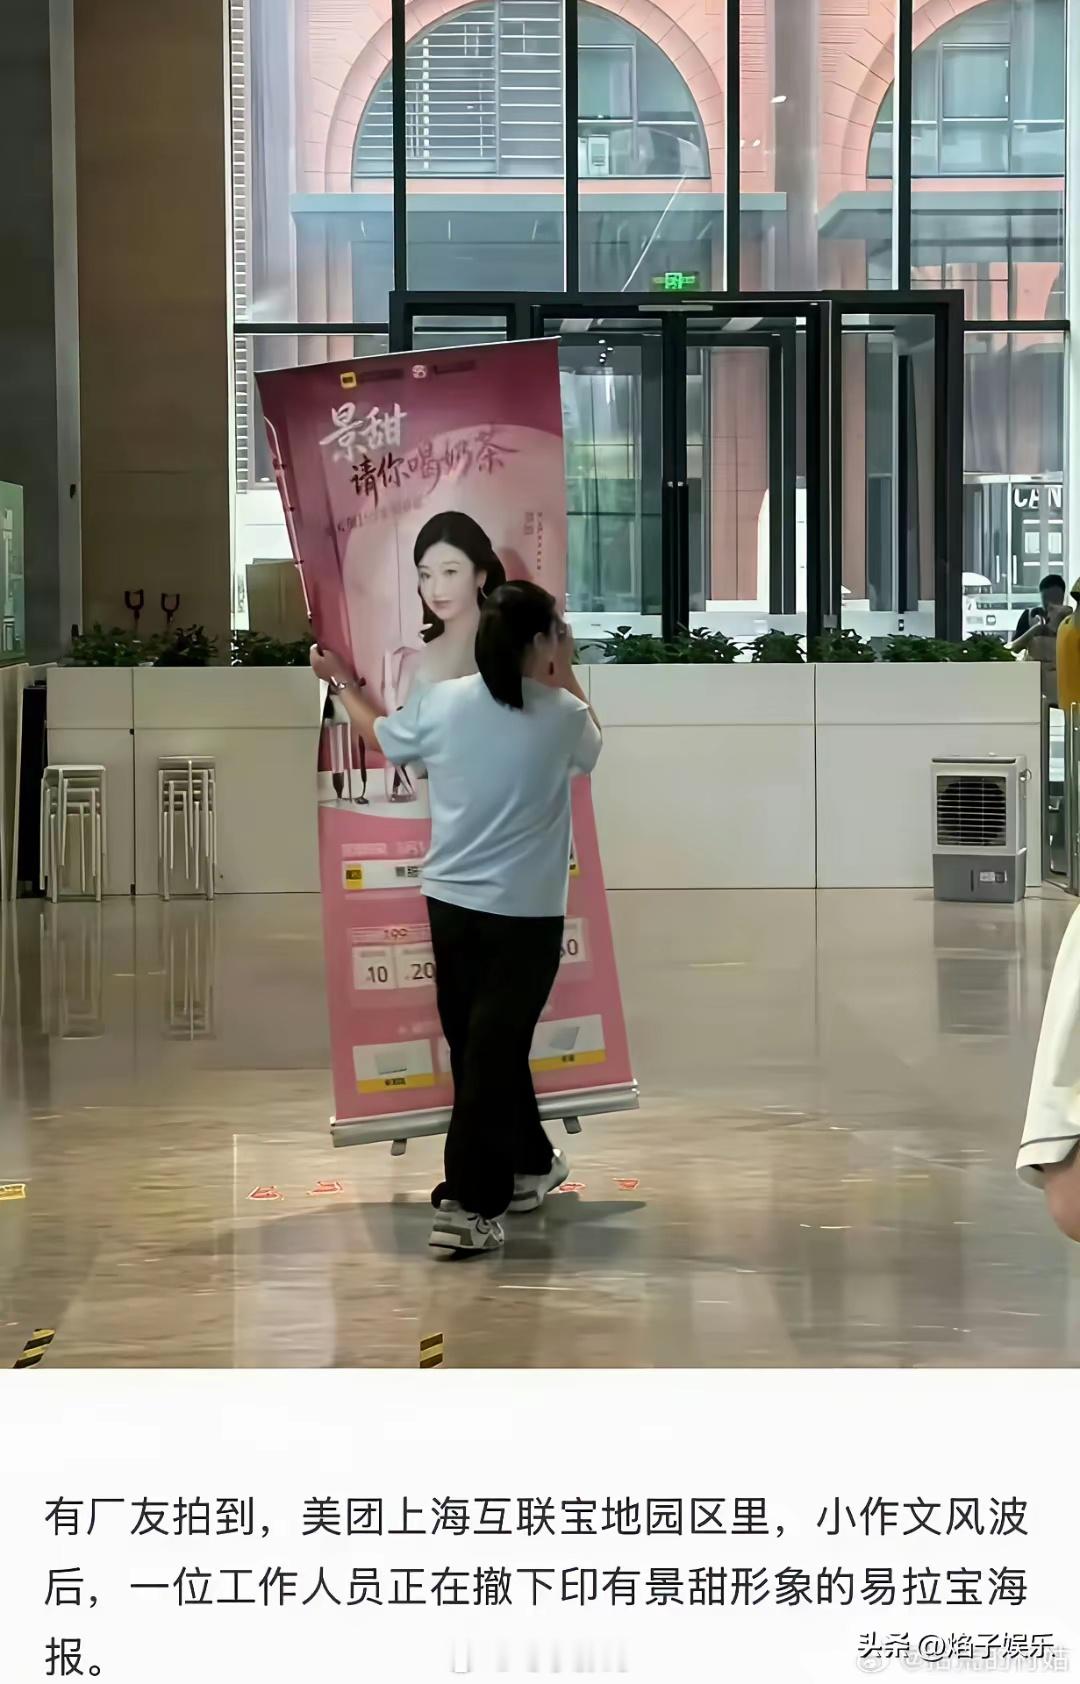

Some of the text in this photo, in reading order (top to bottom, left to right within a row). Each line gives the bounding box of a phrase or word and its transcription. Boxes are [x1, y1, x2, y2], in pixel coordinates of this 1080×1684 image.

[320, 402, 407, 462] 景甜
[350, 424, 521, 508] 请你喝奶茶
[367, 965, 388, 983] 10
[411, 962, 436, 980] 20
